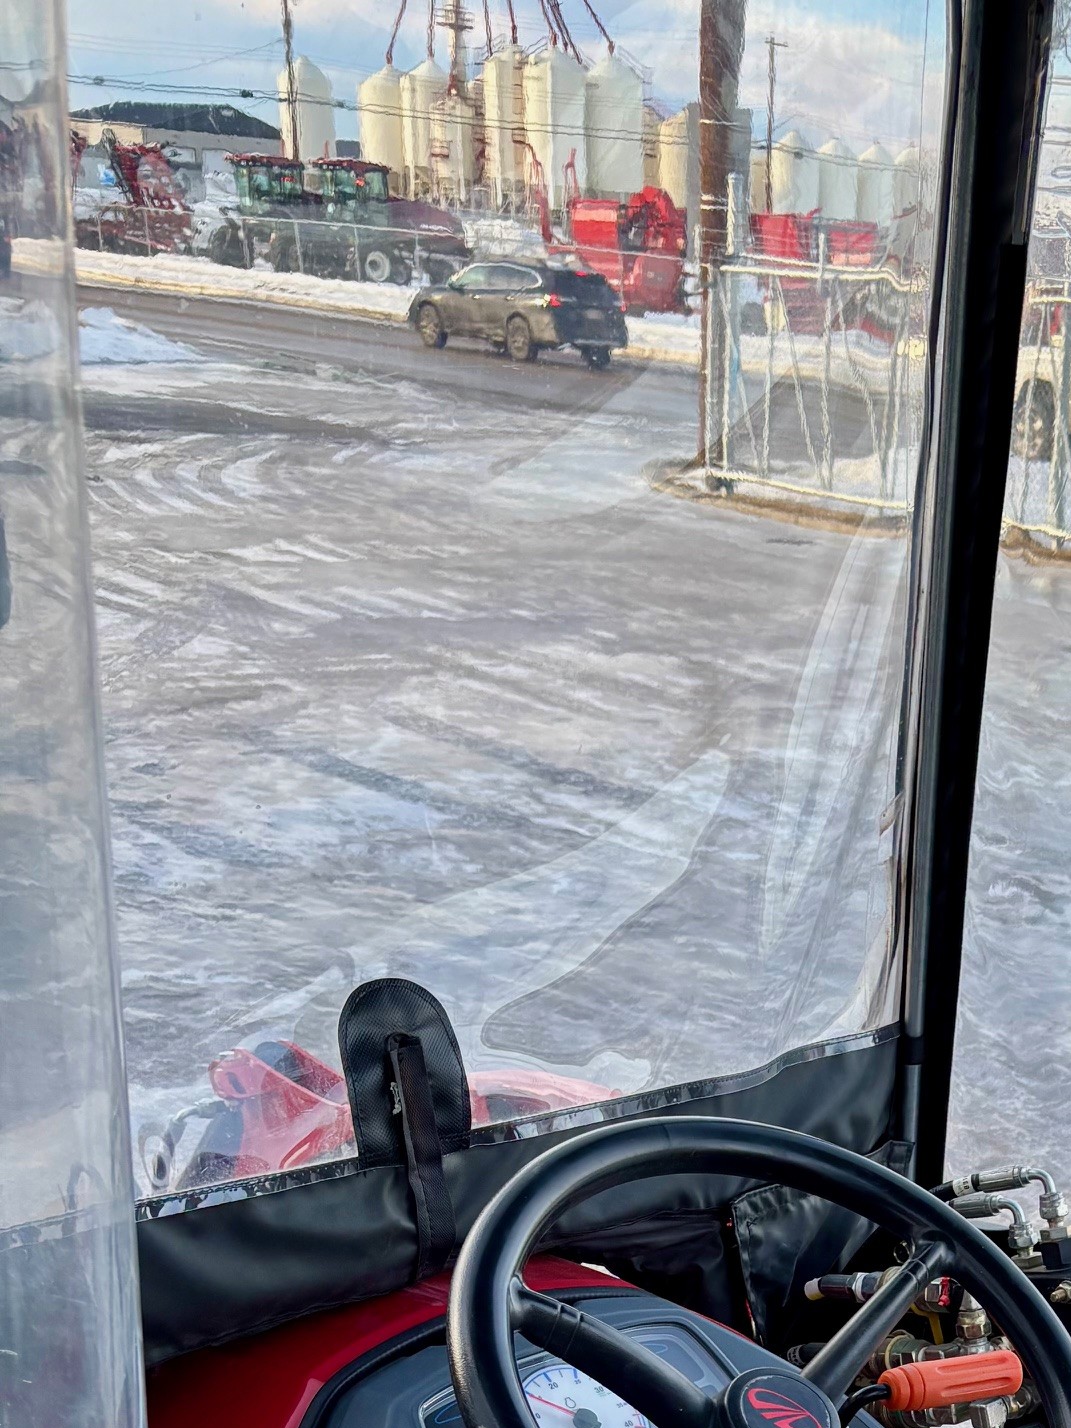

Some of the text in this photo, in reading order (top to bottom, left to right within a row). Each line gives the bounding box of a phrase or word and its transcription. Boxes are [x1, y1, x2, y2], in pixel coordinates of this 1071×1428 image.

[548, 1382, 558, 1390] 20
[594, 1386, 604, 1394] 30
[624, 1420, 634, 1428] 40
